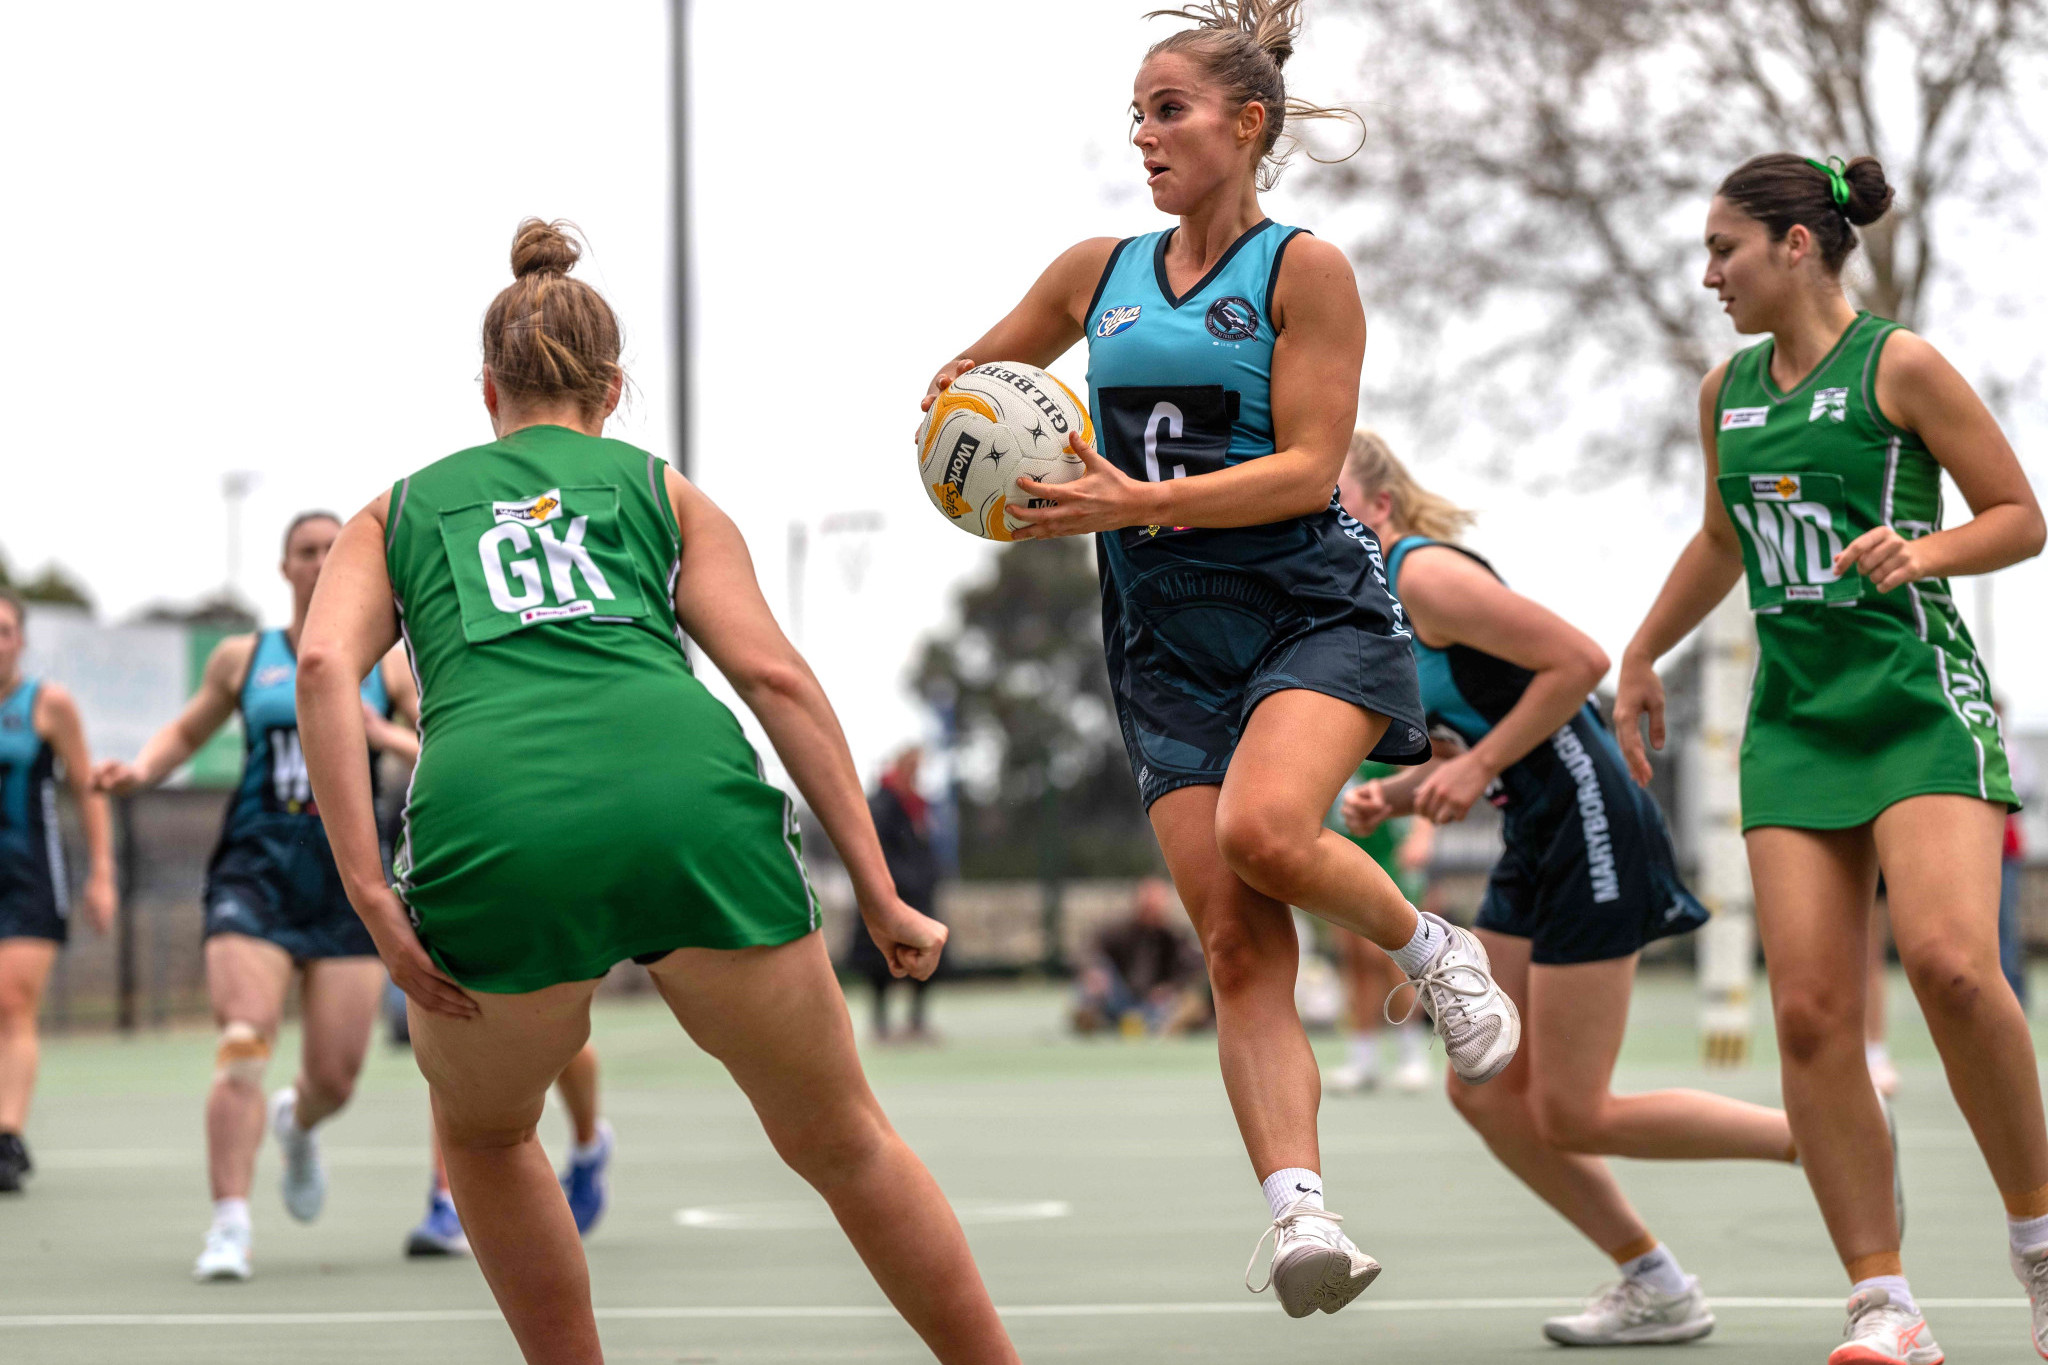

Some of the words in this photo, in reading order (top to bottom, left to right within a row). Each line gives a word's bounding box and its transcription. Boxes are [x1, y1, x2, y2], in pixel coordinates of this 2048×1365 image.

[964, 366, 1069, 434] GILBERT
[1143, 401, 1187, 483] C
[478, 515, 616, 613] GK
[1733, 501, 1845, 588] WD
